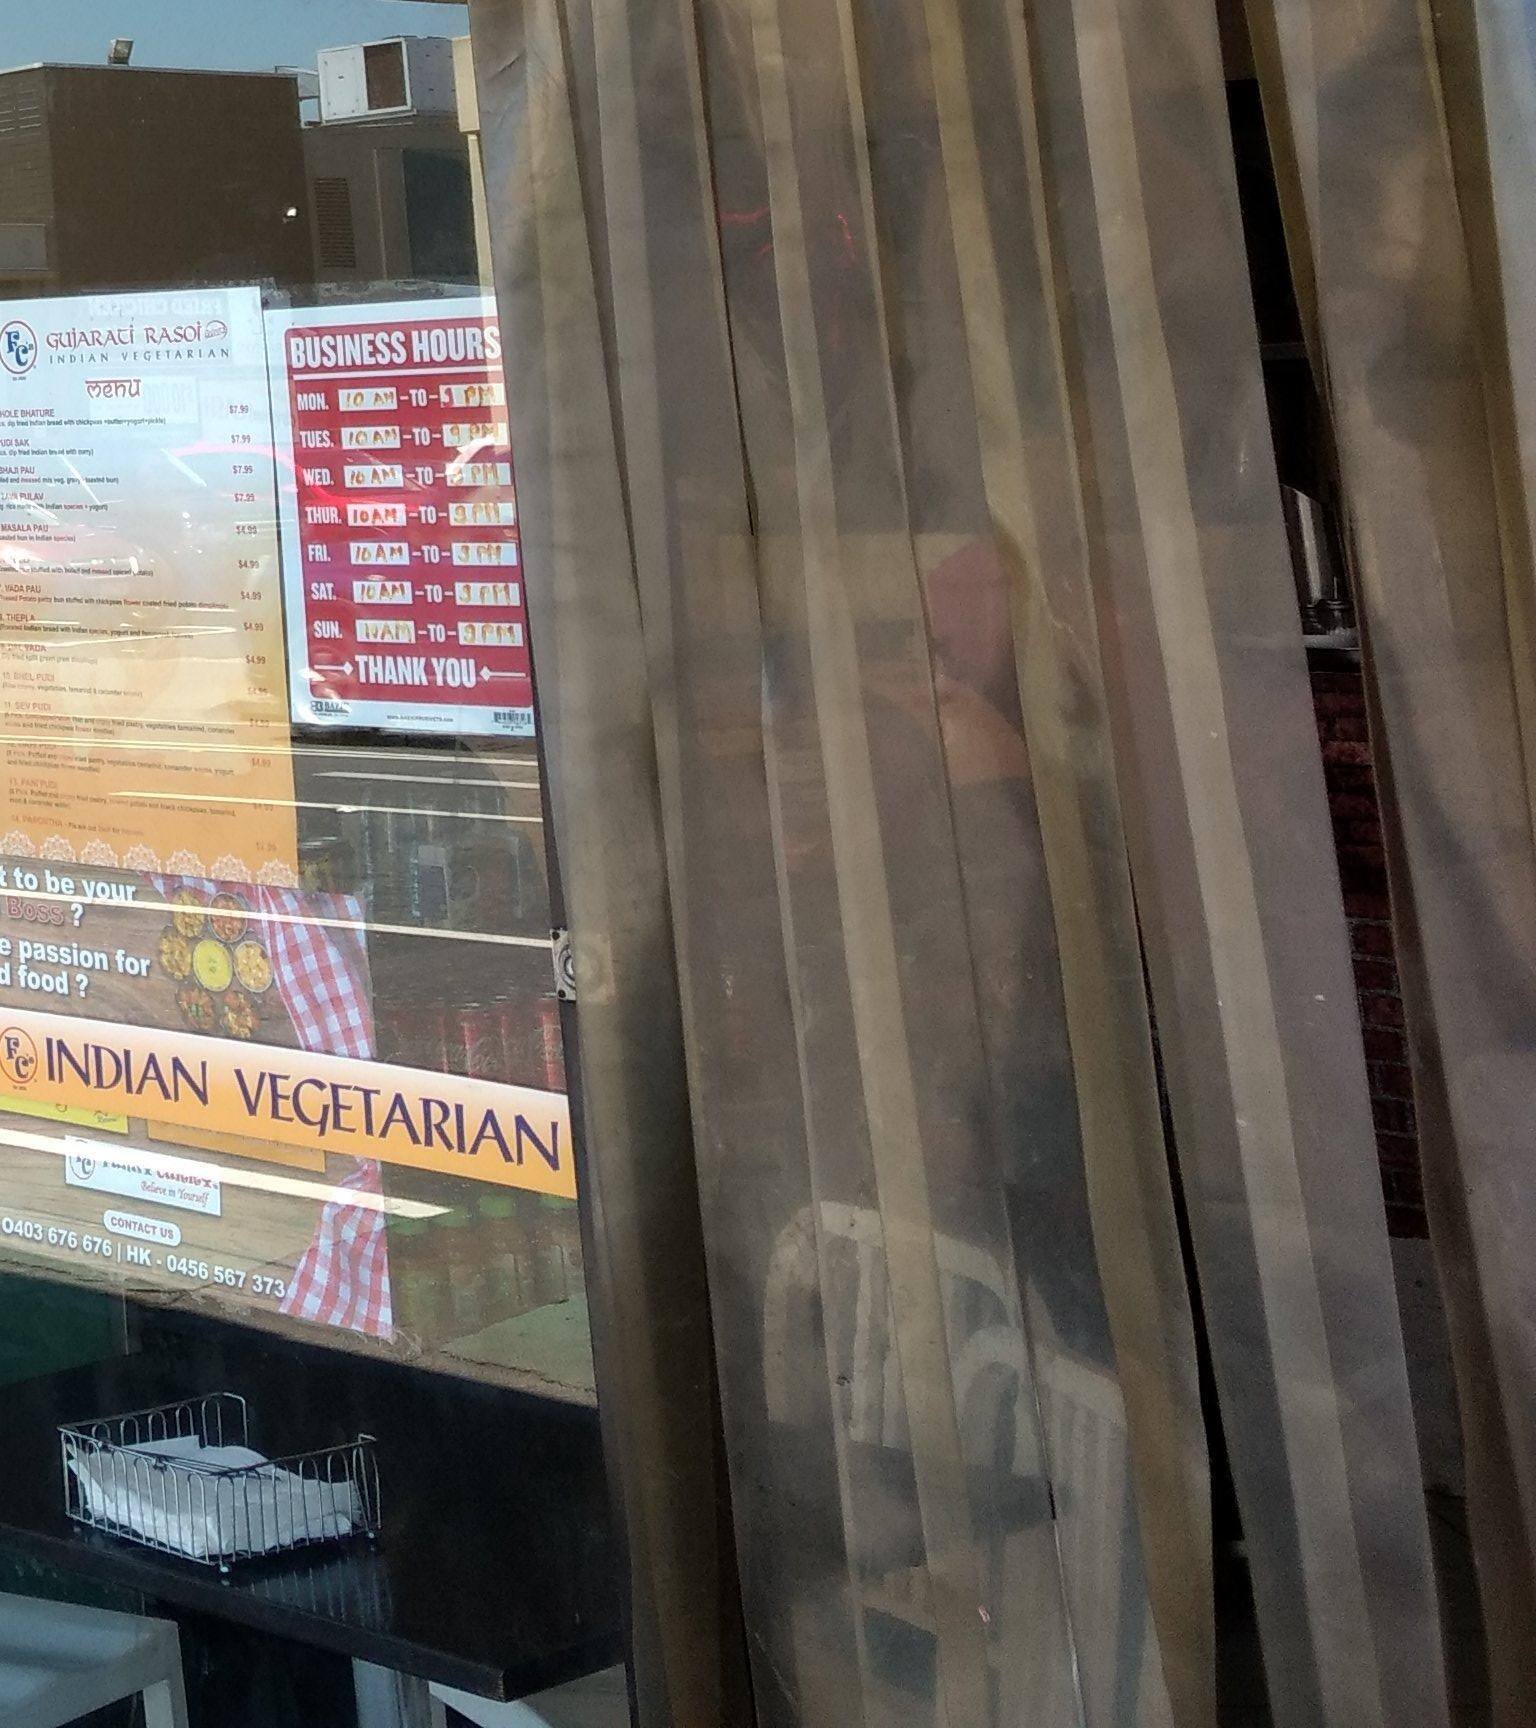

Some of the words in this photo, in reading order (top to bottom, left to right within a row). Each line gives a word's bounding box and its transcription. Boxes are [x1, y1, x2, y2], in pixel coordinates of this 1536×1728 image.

[49, 352, 109, 365] INDIAN
[121, 348, 230, 362] VEGETARIAN
[290, 331, 406, 369] BUSINESS
[412, 325, 501, 363] HOURS
[297, 392, 329, 412] MON.
[300, 430, 334, 448] TUES.
[303, 468, 334, 486] WED.
[305, 505, 342, 524] THUR.
[308, 544, 331, 562] FRI.
[310, 583, 337, 601] SAT.
[313, 621, 343, 639] SUN.
[354, 654, 429, 686] THANK
[431, 657, 477, 688] YOU
[13, 866, 38, 891] to
[44, 869, 75, 895] be
[81, 878, 137, 906] your
[18, 938, 110, 972] passion
[115, 948, 152, 978] for
[17, 964, 70, 996] food
[45, 1036, 209, 1108] INDIAN
[233, 1067, 560, 1172] VEGETARIAN
[110, 1215, 157, 1237] CONTACT
[159, 1226, 175, 1241] US
[1, 1216, 44, 1242] 0403
[47, 1226, 79, 1249] 676
[82, 1234, 113, 1258] 676
[126, 1244, 153, 1267] HK
[166, 1253, 210, 1281] 0456
[213, 1265, 247, 1290] 567
[252, 1273, 286, 1299] 373
